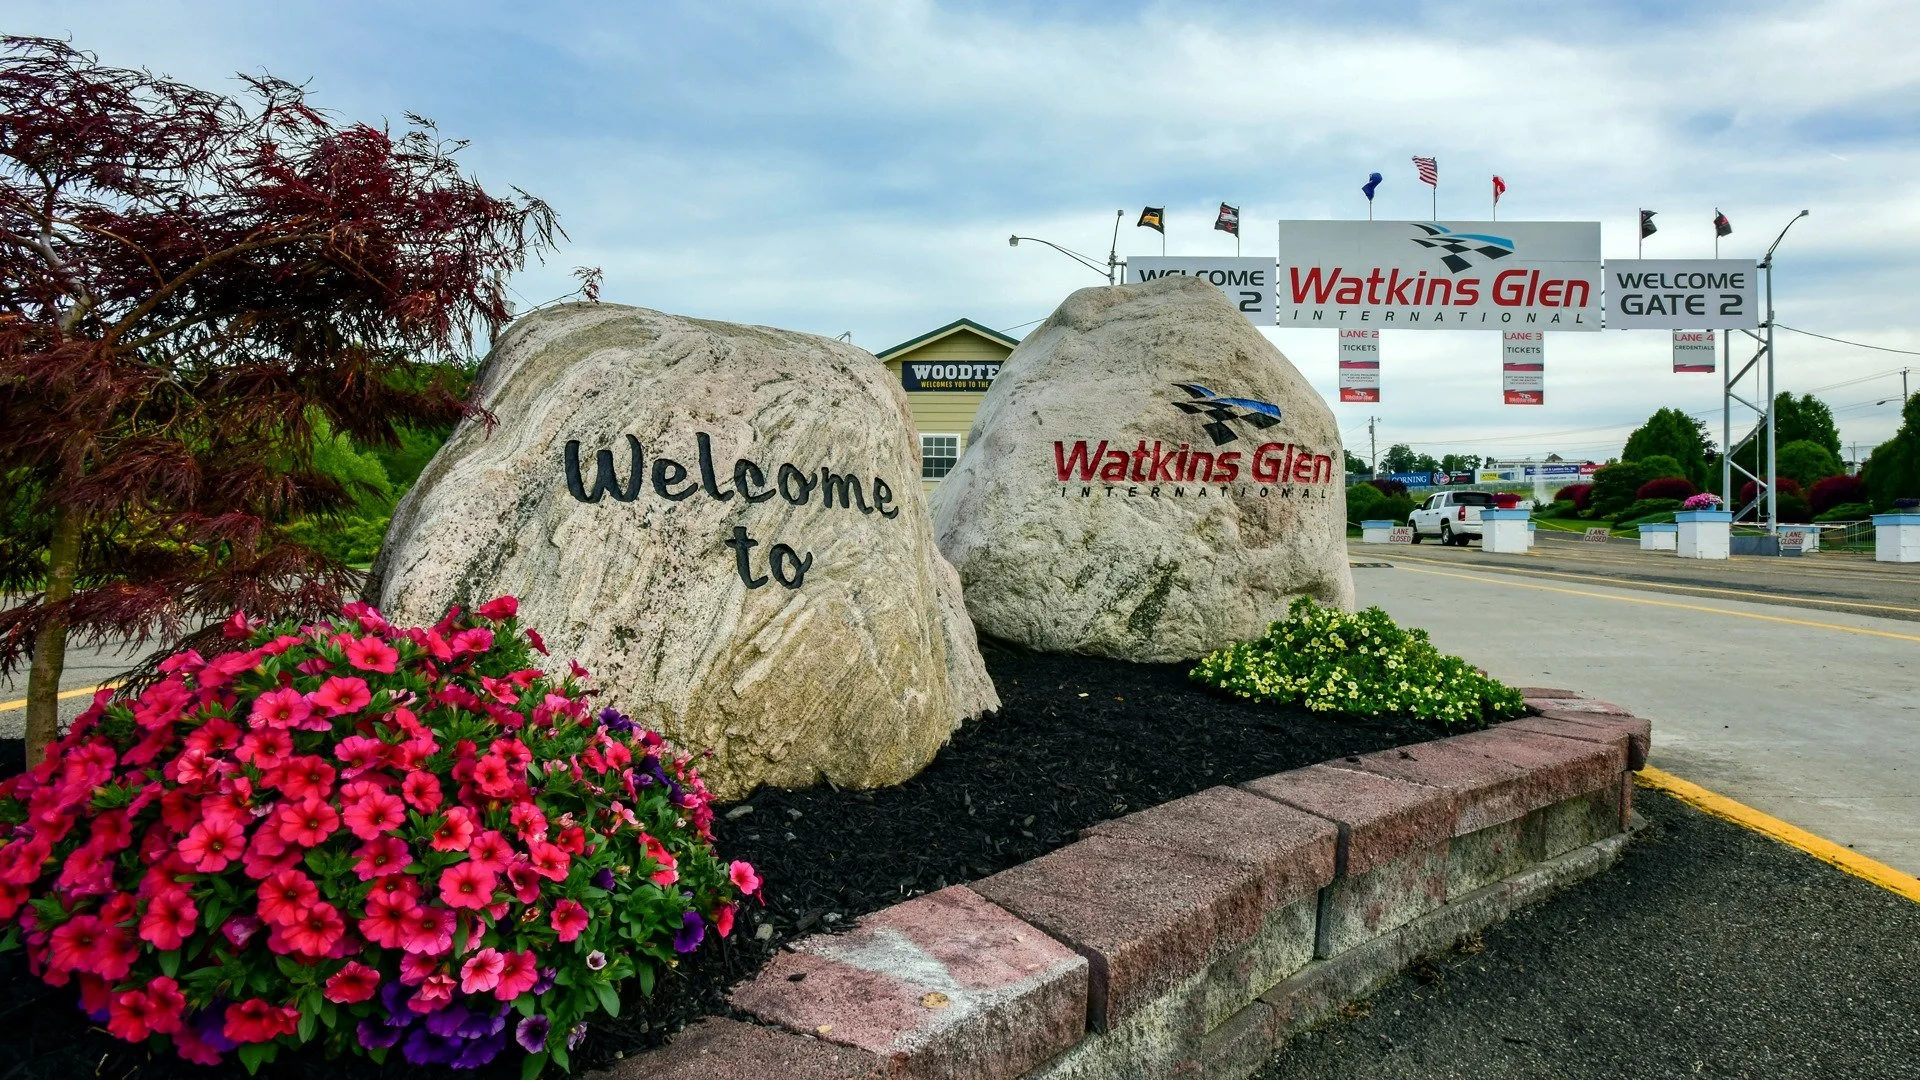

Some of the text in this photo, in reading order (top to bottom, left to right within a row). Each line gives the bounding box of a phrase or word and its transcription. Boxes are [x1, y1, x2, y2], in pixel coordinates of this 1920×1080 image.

[1290, 267, 1590, 307] Watkins Glen
[1616, 273, 1745, 289] WELCOME
[1239, 291, 1263, 312] 2
[1620, 294, 1743, 316] GATE 2
[1293, 310, 1584, 324] INTERNATIONAL
[1340, 330, 1379, 338] LANE 2
[1504, 332, 1532, 340] LANE
[1674, 333, 1715, 342] LANE 4
[1054, 440, 1332, 484] Watkins Glen
[564, 431, 899, 519] Welcome
[1061, 486, 1327, 499] INTERNATIONAL
[724, 526, 813, 589] to
